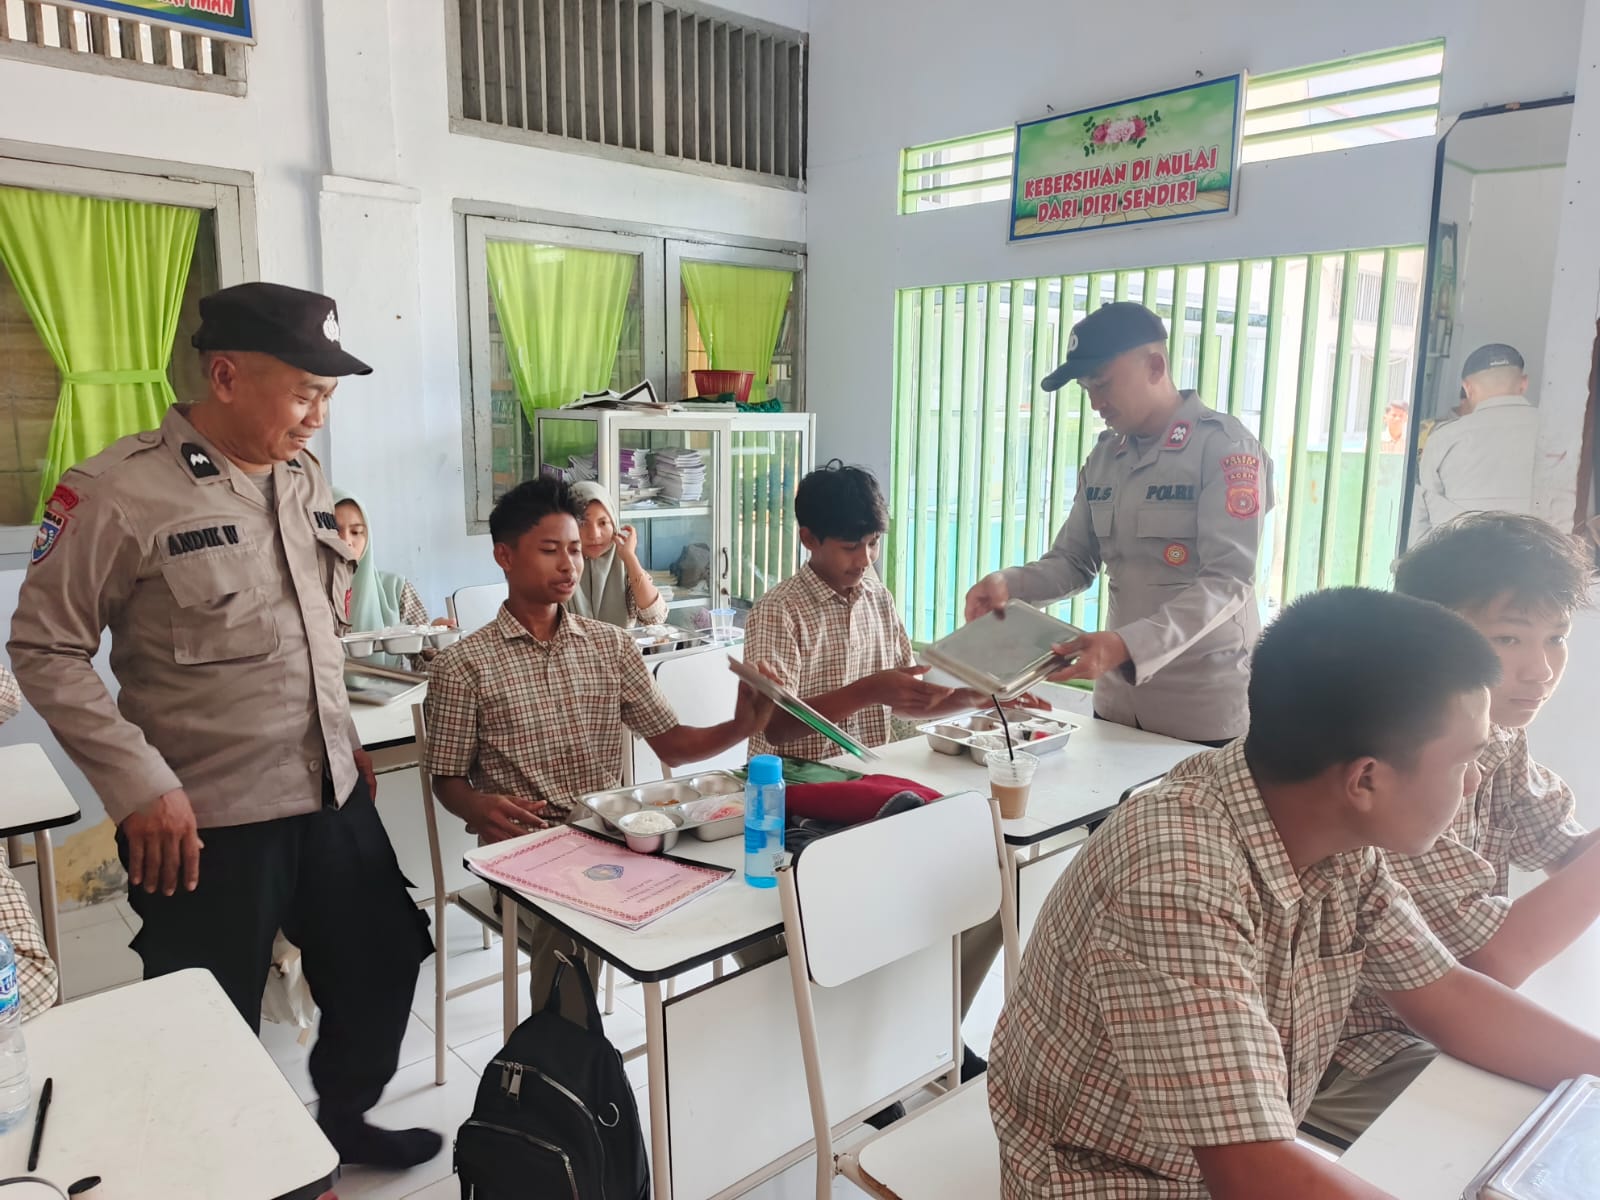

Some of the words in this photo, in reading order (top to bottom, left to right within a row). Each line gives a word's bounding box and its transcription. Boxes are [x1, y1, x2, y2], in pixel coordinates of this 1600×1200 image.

[1024, 163, 1127, 199] KEBERSIHAN
[1131, 159, 1151, 182] DI
[1155, 147, 1217, 177] MULAI
[1038, 198, 1078, 223] DARI
[1082, 192, 1118, 217] DIRI
[1121, 179, 1196, 211] SENDIRI
[1145, 484, 1196, 501] POLRI
[168, 526, 225, 556] ANDIK
[222, 524, 239, 545] W
